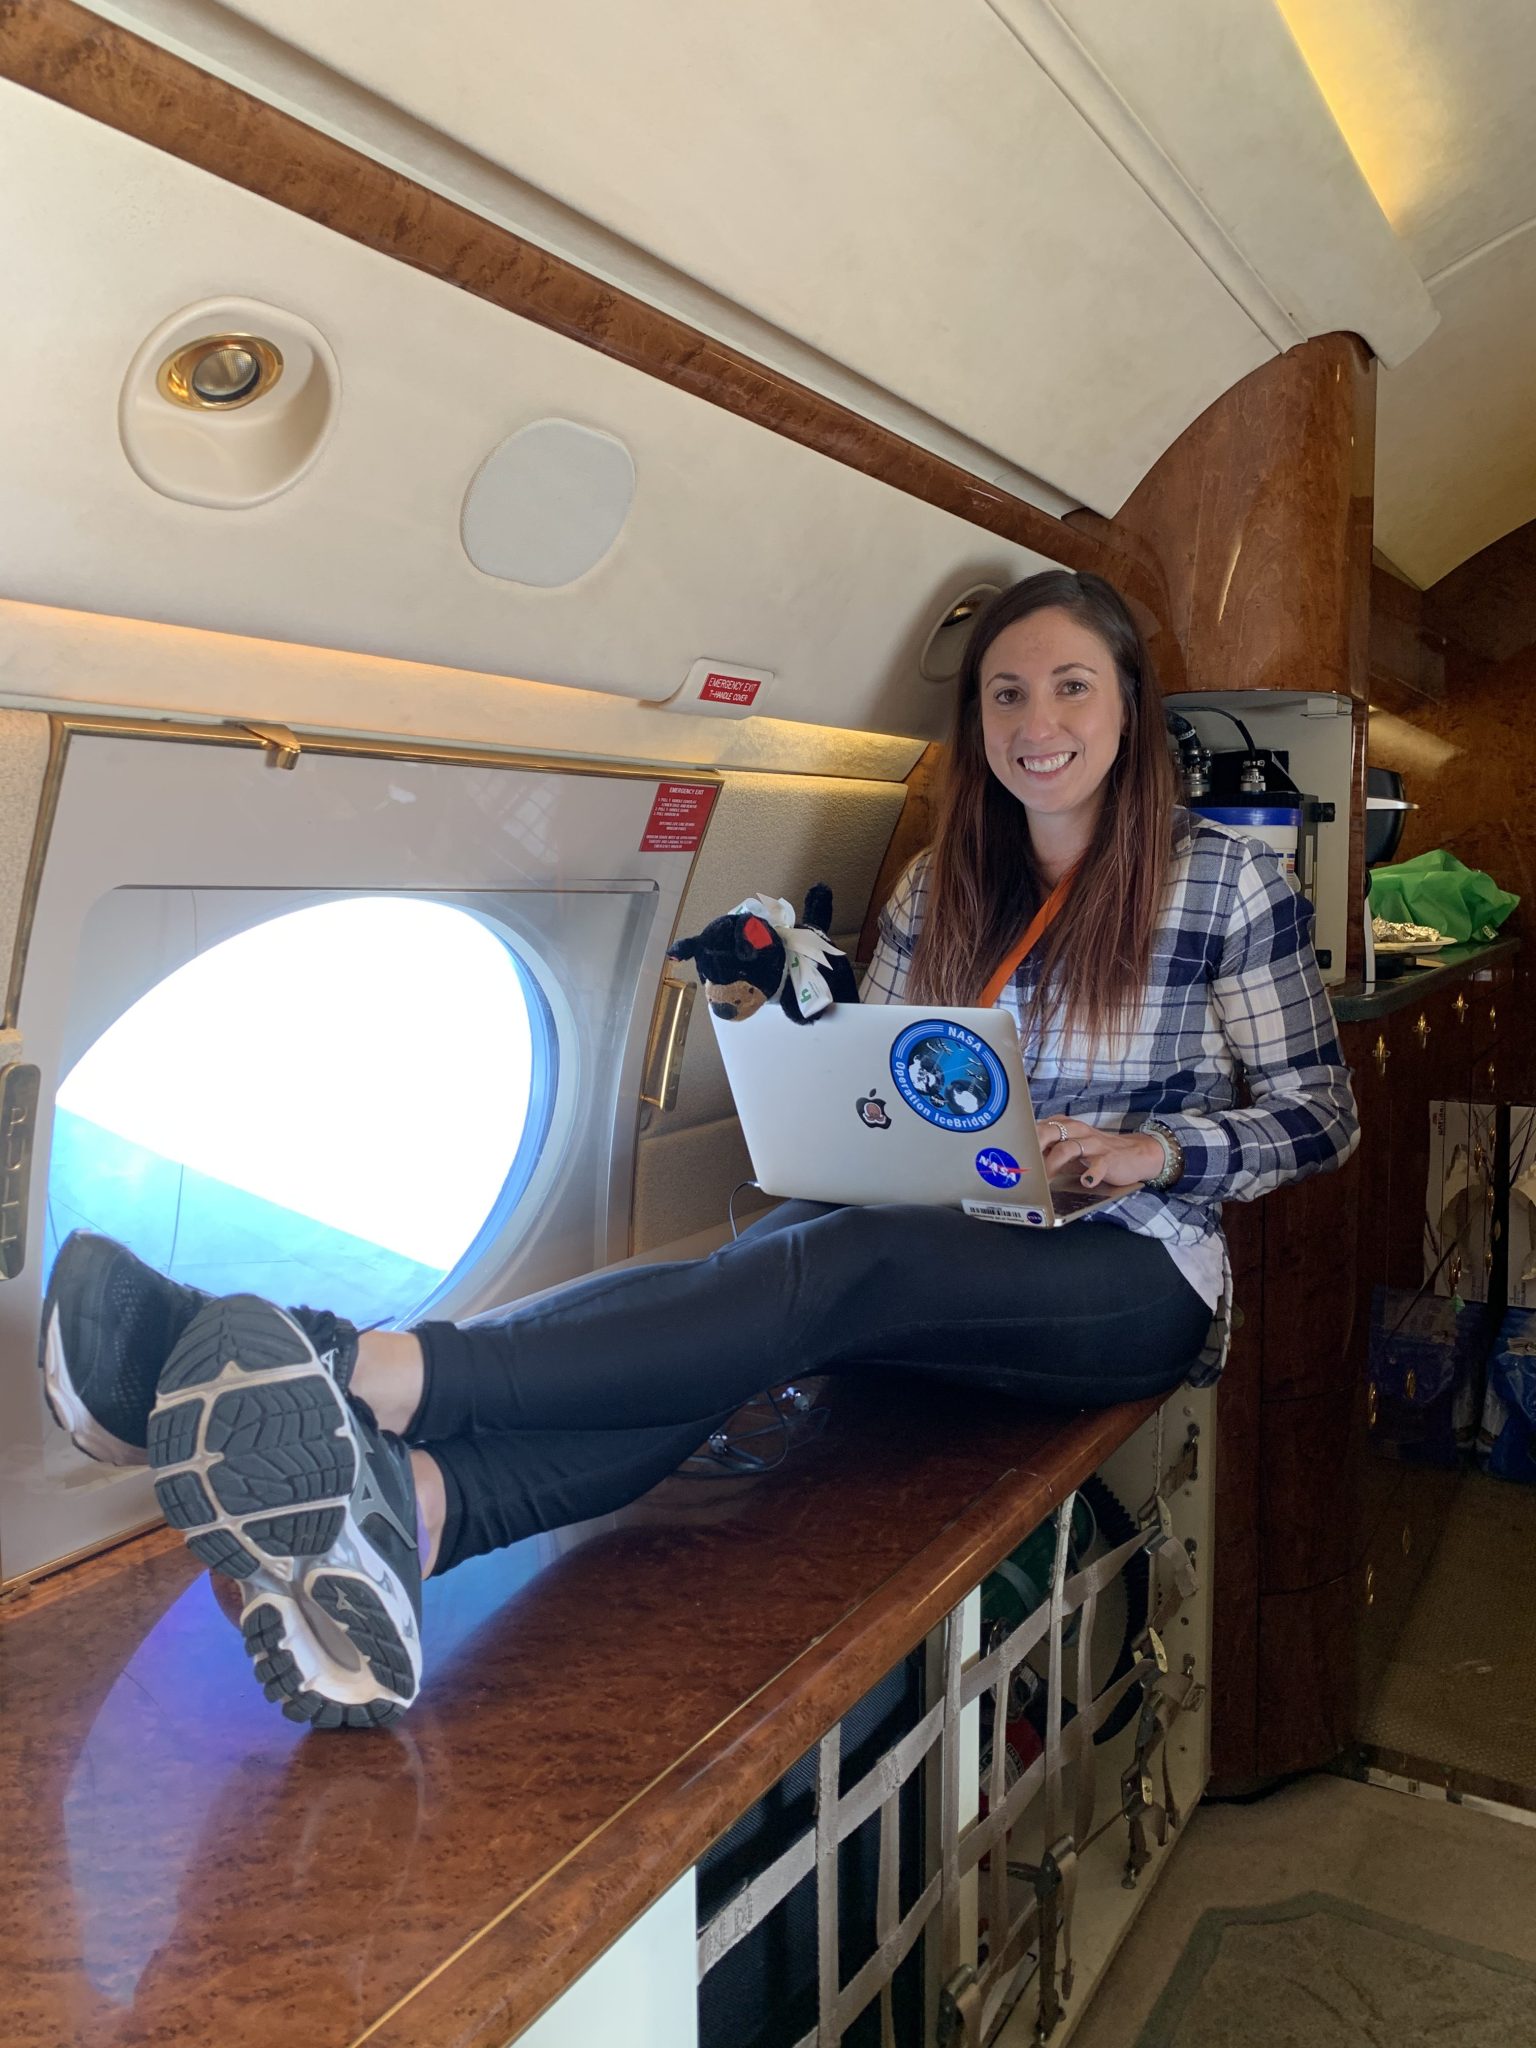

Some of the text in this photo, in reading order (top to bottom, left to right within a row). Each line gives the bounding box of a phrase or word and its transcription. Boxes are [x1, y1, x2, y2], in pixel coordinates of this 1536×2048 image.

[708, 677, 758, 692] EMERGENCY EXIT
[709, 689, 748, 702] T-HANDLE COVER
[669, 786, 695, 795] EMERGENCY
[947, 1026, 982, 1053] NASA
[894, 1060, 992, 1128] Operation IceBridge
[0, 1105, 29, 1244] PULL
[978, 1154, 1018, 1183] NASA
